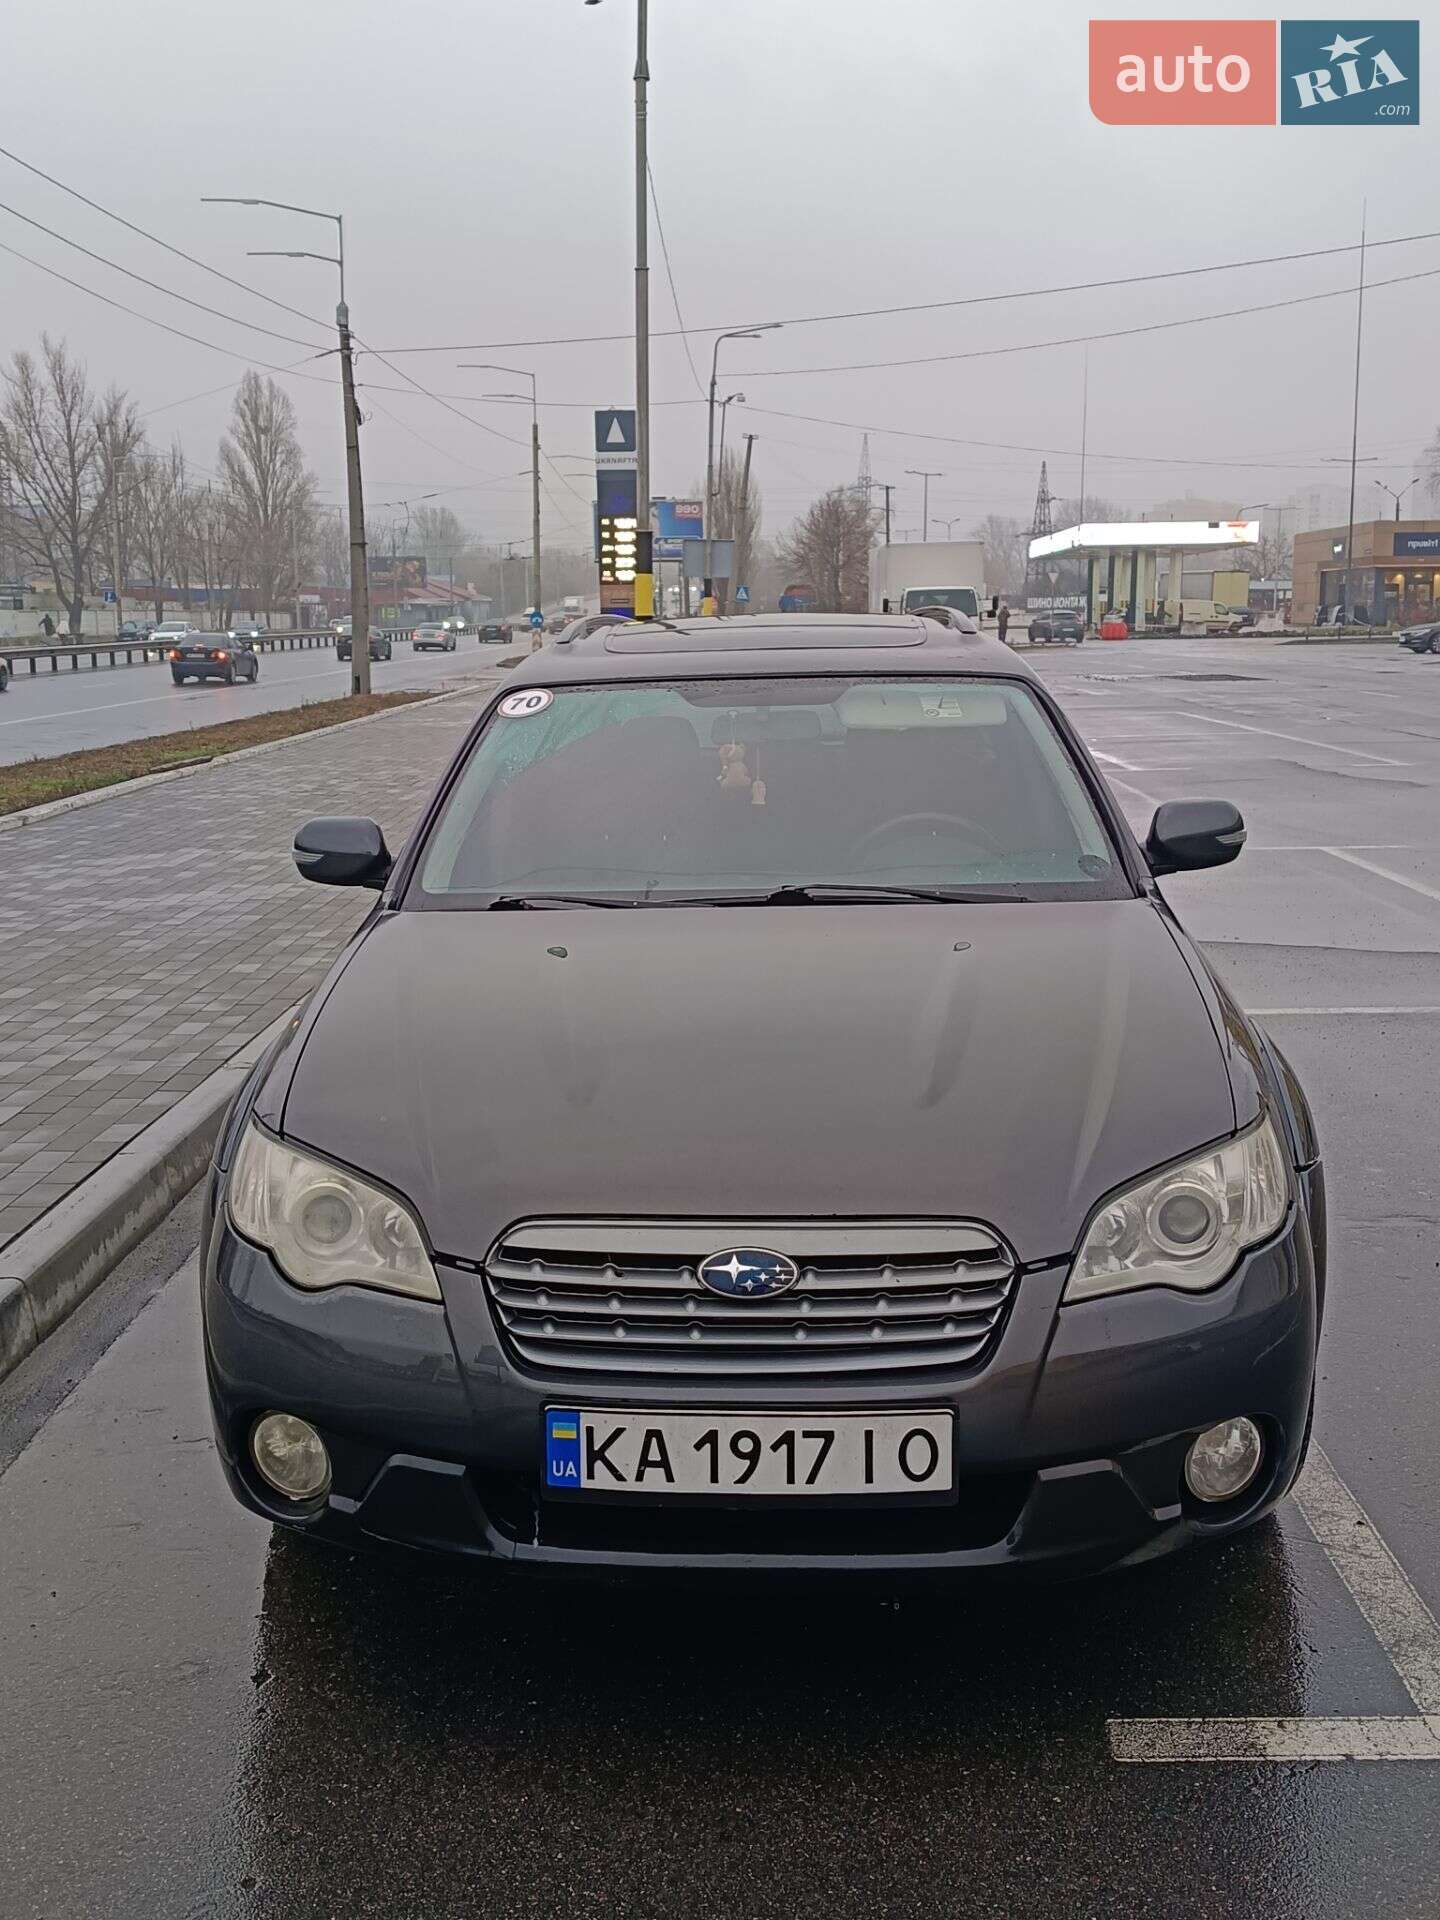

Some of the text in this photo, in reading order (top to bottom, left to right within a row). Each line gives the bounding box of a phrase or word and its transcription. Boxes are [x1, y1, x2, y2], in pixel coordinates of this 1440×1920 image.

[510, 696, 542, 710] 70
[584, 1425, 940, 1486] KA 1917 IO
[552, 1460, 578, 1478] UA
